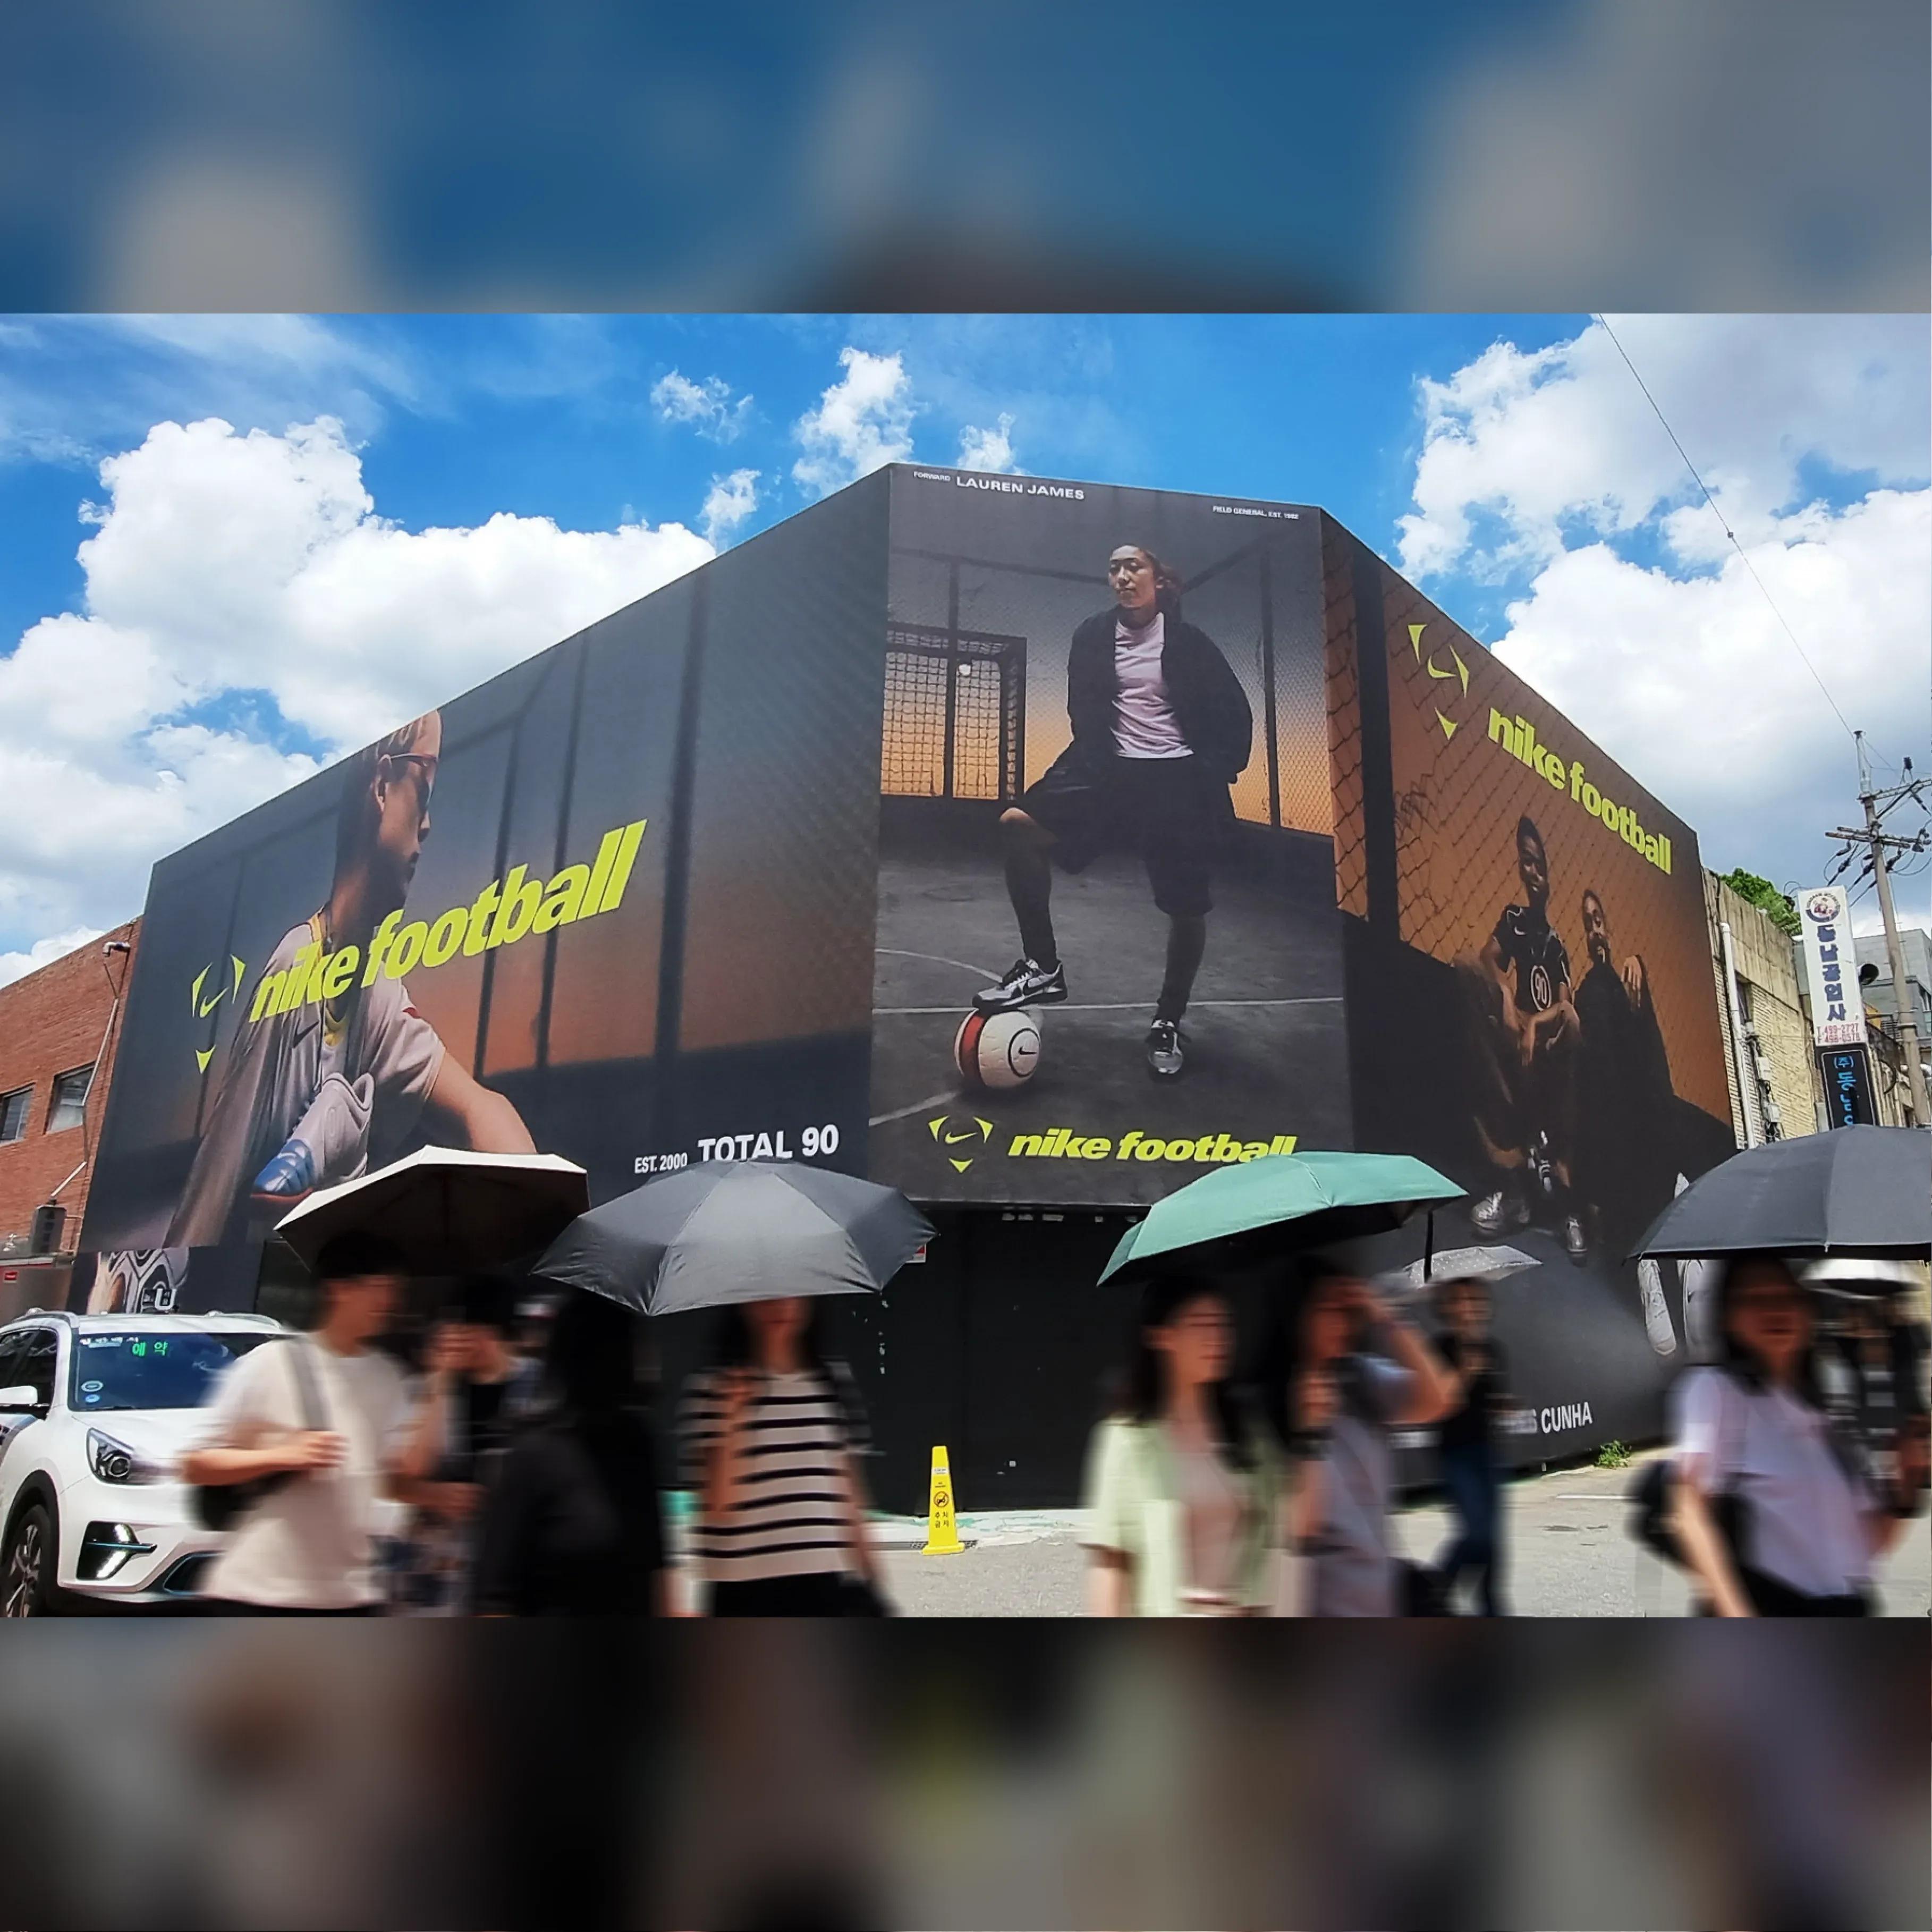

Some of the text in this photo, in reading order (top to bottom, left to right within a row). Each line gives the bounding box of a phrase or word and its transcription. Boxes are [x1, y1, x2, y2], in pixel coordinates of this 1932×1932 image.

[913, 471, 1084, 500] FORWARD LAUREN JAMES
[1488, 707, 1672, 875] nike football
[249, 819, 648, 1023] nike football
[1535, 973, 1548, 1004] 90
[634, 1124, 839, 1173] EST. 2000 TOTAL 90
[1008, 1128, 1297, 1163] nike football
[1541, 1401, 1593, 1434] CUNHA
